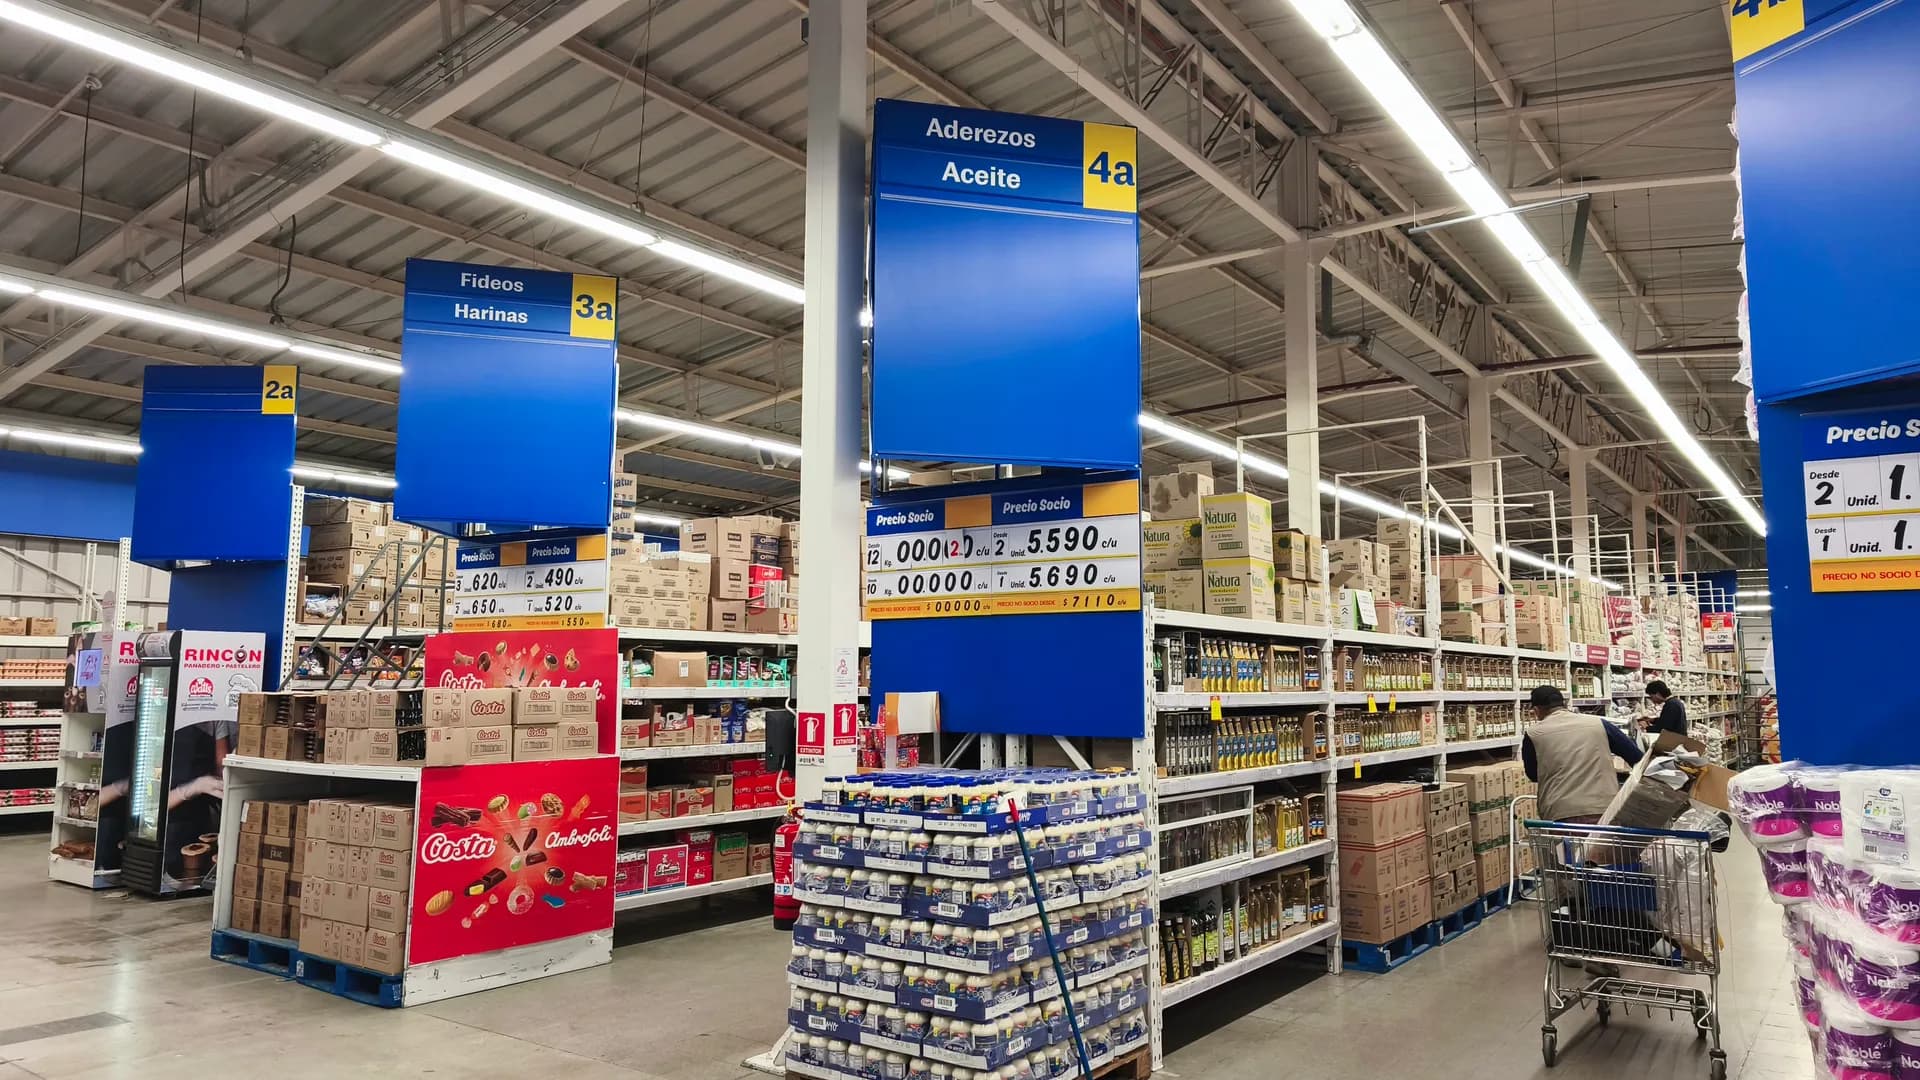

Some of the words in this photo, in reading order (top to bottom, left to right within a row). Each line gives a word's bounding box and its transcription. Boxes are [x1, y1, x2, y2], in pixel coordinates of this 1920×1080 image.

[926, 117, 1036, 148] Aderezos
[942, 161, 1021, 189] Aceite
[1088, 151, 1135, 186] 4a
[460, 272, 524, 292] Fideos
[455, 303, 528, 324] Harinas
[575, 294, 613, 321] 3a
[265, 380, 294, 400] 2a
[1826, 420, 1901, 444] Precio
[1809, 470, 1840, 480] Desde
[1814, 481, 1834, 506] 2
[1847, 495, 1879, 507] Unid.
[1002, 499, 1038, 514] Precio
[1039, 496, 1071, 511] Socio
[876, 512, 907, 526] Precio
[907, 509, 934, 523] Socio
[1204, 511, 1237, 524] Natura
[995, 540, 1005, 556] 2
[1027, 525, 1099, 553] 5.590
[1101, 538, 1117, 548] c/u
[1143, 530, 1170, 542] Natura
[1822, 535, 1830, 551] 1
[1849, 542, 1882, 553] Unid.
[461, 552, 478, 562] Precio
[479, 551, 495, 560] Socio
[531, 546, 552, 557] Precio
[552, 545, 570, 555] Socio
[867, 550, 879, 565] 12
[976, 546, 990, 556] c/u
[473, 572, 498, 591] 620
[526, 576, 533, 588] 2
[545, 567, 574, 587] 490
[1029, 563, 1098, 588] 5.690
[1207, 574, 1241, 588] Natura
[1822, 573, 1857, 581] PRECIO
[1861, 572, 1876, 580] NO
[1880, 571, 1912, 579] SOCIO
[867, 583, 877, 595] 10
[472, 599, 497, 614] 650
[545, 595, 573, 612] 520
[567, 617, 584, 626] 550
[184, 644, 262, 663] RINCÓN
[529, 690, 551, 700] Costa
[567, 691, 587, 700] Costa
[471, 699, 506, 716] Costa
[477, 729, 501, 740] Costa
[526, 727, 548, 737] Costa
[567, 726, 589, 736] Costa
[1814, 800, 1840, 811] Nob
[421, 833, 496, 864] Costa
[1901, 1054, 1920, 1069] No
